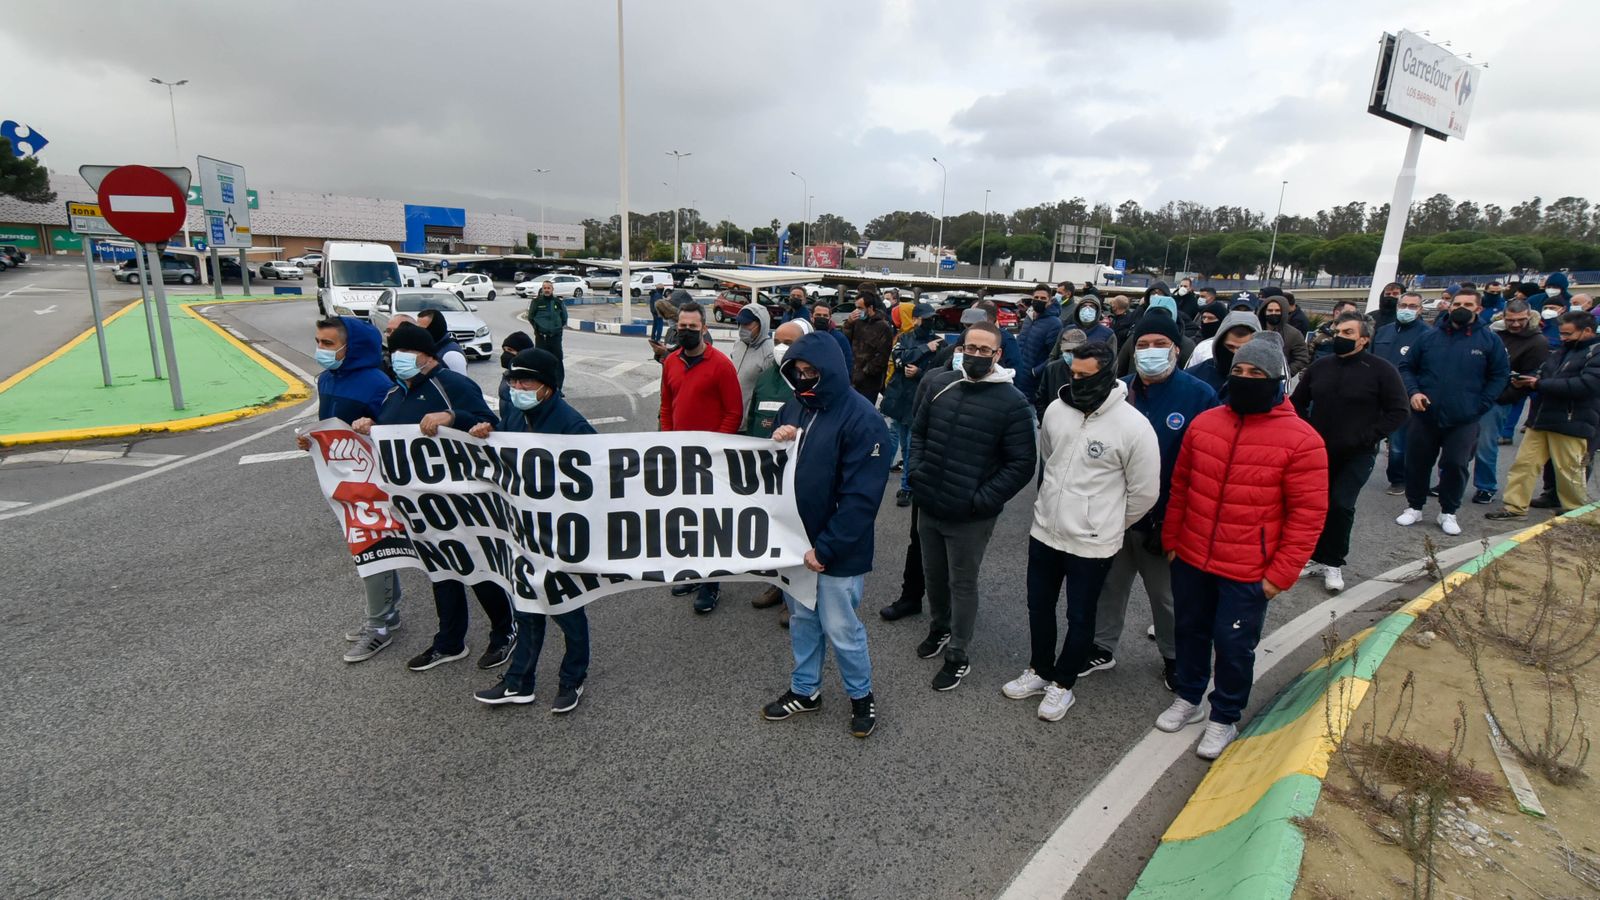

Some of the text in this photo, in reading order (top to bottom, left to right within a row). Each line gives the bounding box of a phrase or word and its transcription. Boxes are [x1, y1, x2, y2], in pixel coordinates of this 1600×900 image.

[1402, 47, 1452, 92] Carrefour
[1406, 86, 1416, 98] LOS
[72, 207, 96, 216] zona
[609, 445, 714, 499] POR
[723, 448, 789, 496] UN
[348, 526, 407, 543] EAL
[607, 507, 781, 560] DIGNO.
[362, 551, 376, 561] DE
[376, 547, 417, 558] GIBRALTAR
[412, 539, 475, 576] NO
